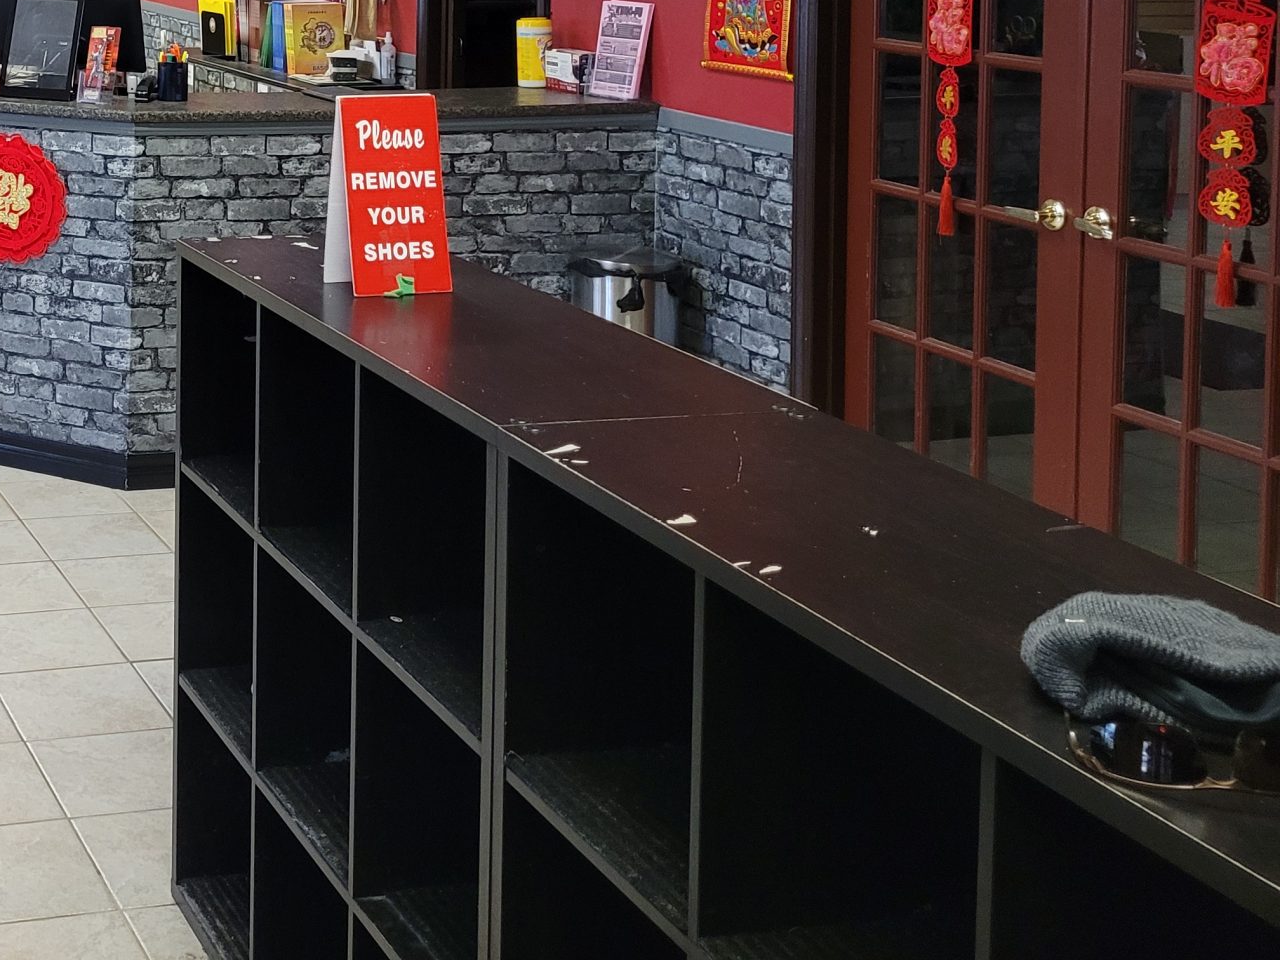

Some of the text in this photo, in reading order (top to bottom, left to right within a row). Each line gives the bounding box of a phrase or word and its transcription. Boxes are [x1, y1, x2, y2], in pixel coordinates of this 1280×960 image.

[355, 119, 425, 150] Please
[351, 170, 437, 191] REMOVE
[367, 206, 425, 225] YOUR
[364, 240, 435, 262] SHOES
